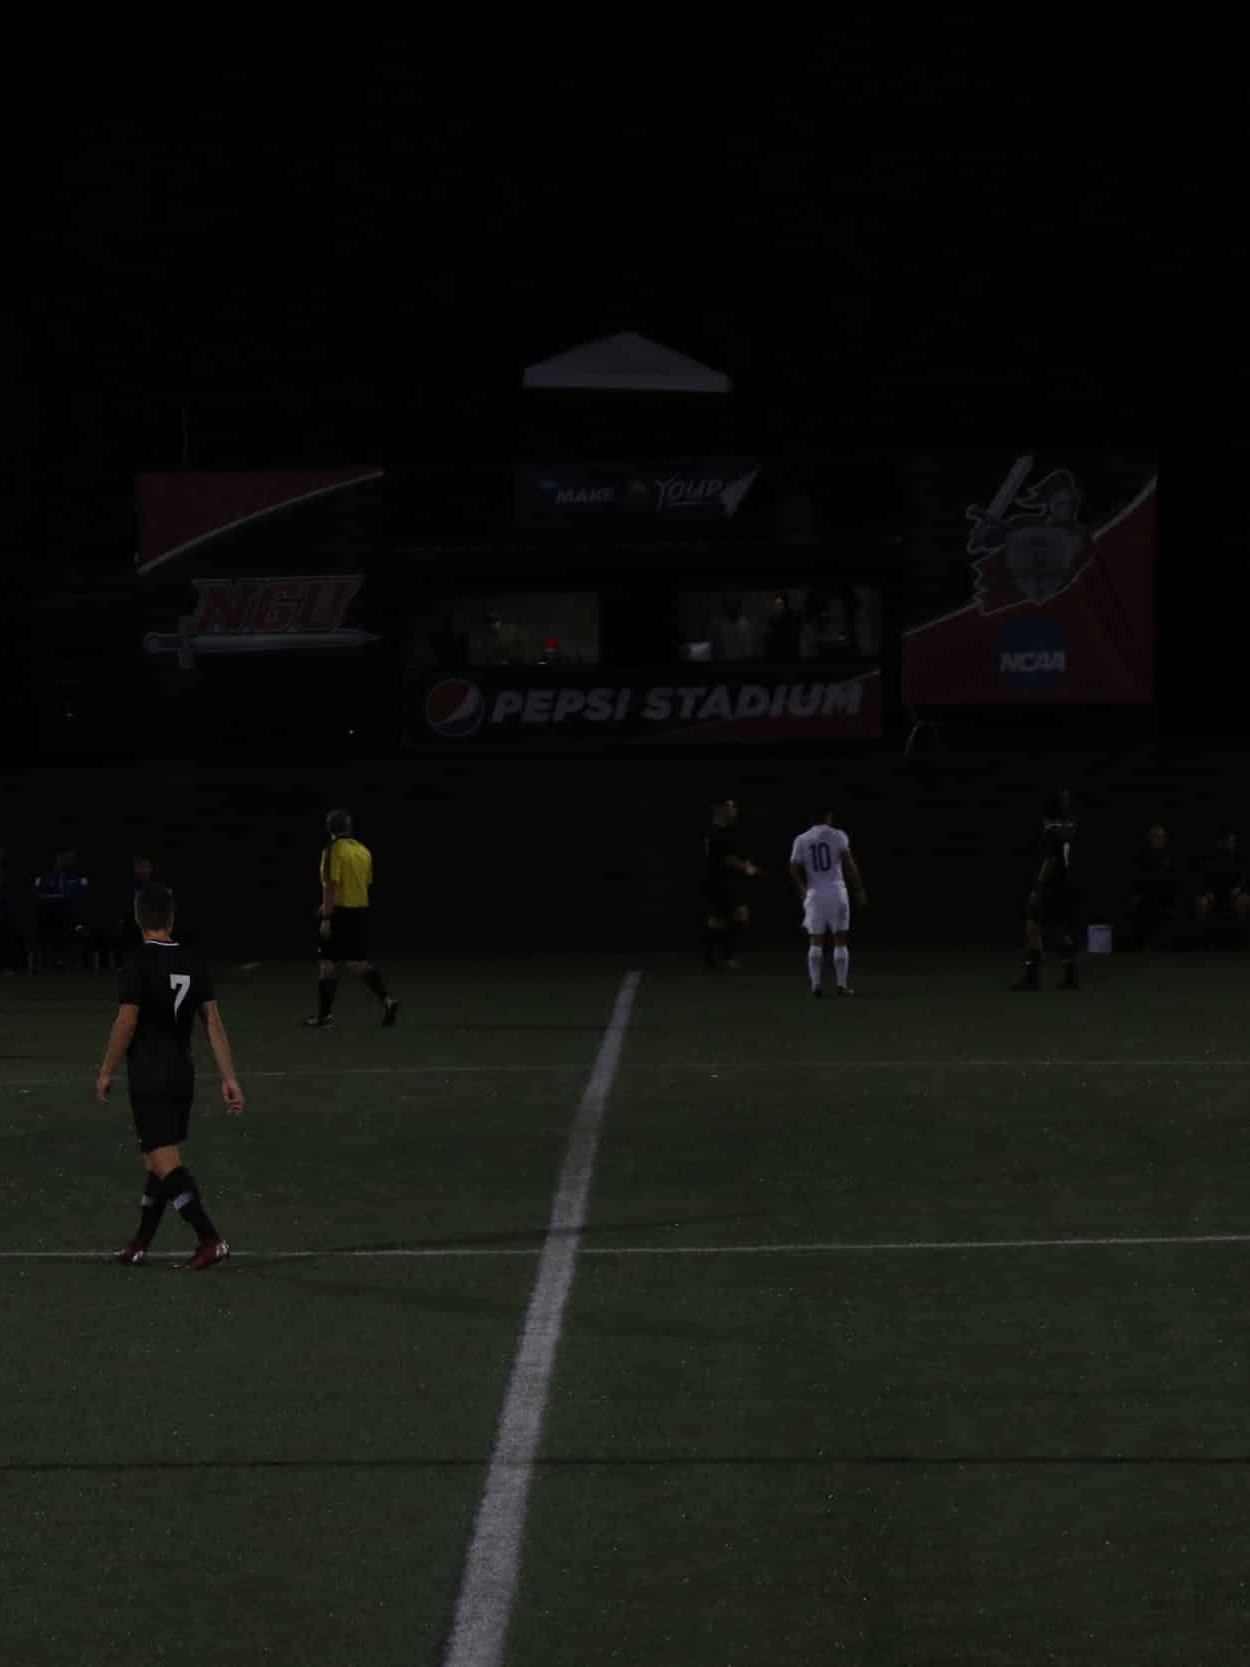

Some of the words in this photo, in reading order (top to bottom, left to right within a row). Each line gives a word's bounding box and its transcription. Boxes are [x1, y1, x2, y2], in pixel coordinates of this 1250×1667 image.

[554, 486, 616, 504] MAKE
[191, 576, 364, 632] NGU
[998, 651, 1067, 673] NCAA
[491, 688, 632, 724] PEPSI
[639, 680, 864, 721] STADIUM
[809, 842, 831, 872] 10
[169, 972, 192, 1023] 7
